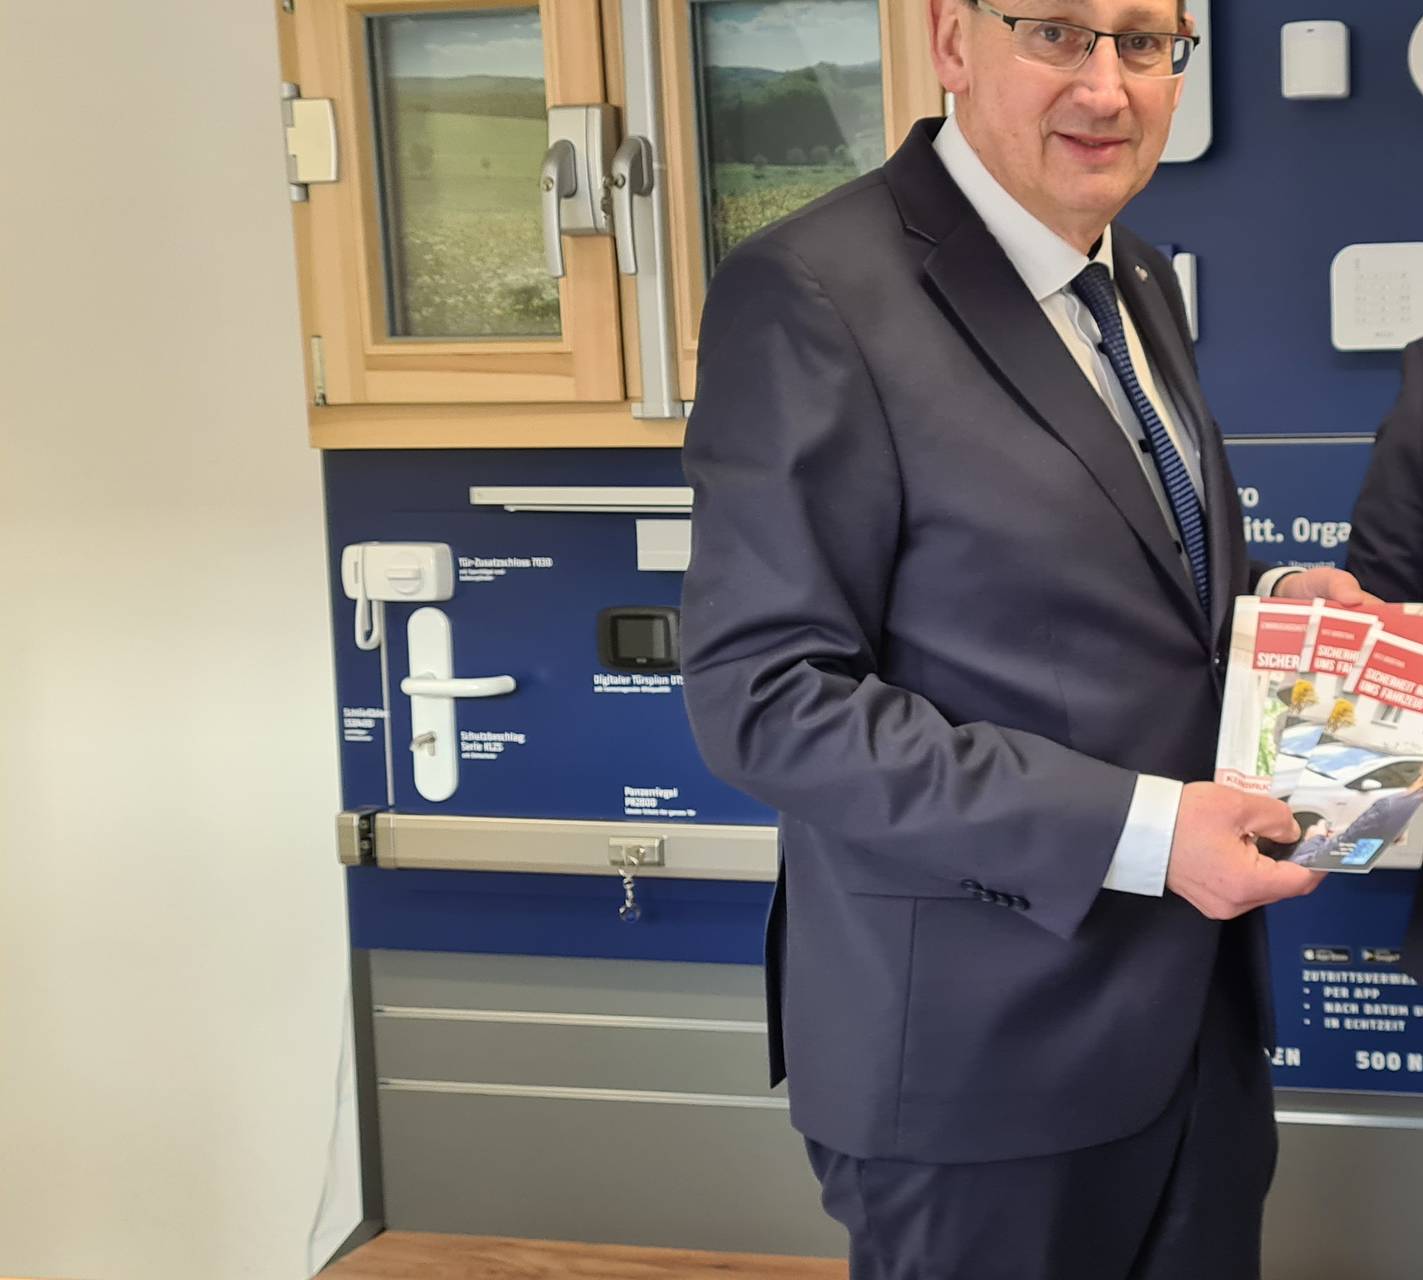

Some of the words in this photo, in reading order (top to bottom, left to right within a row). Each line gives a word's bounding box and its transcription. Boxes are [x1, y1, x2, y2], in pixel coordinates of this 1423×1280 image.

[1323, 986, 1350, 999] PER
[1353, 987, 1381, 1000] APP
[1355, 1050, 1401, 1071] 500
